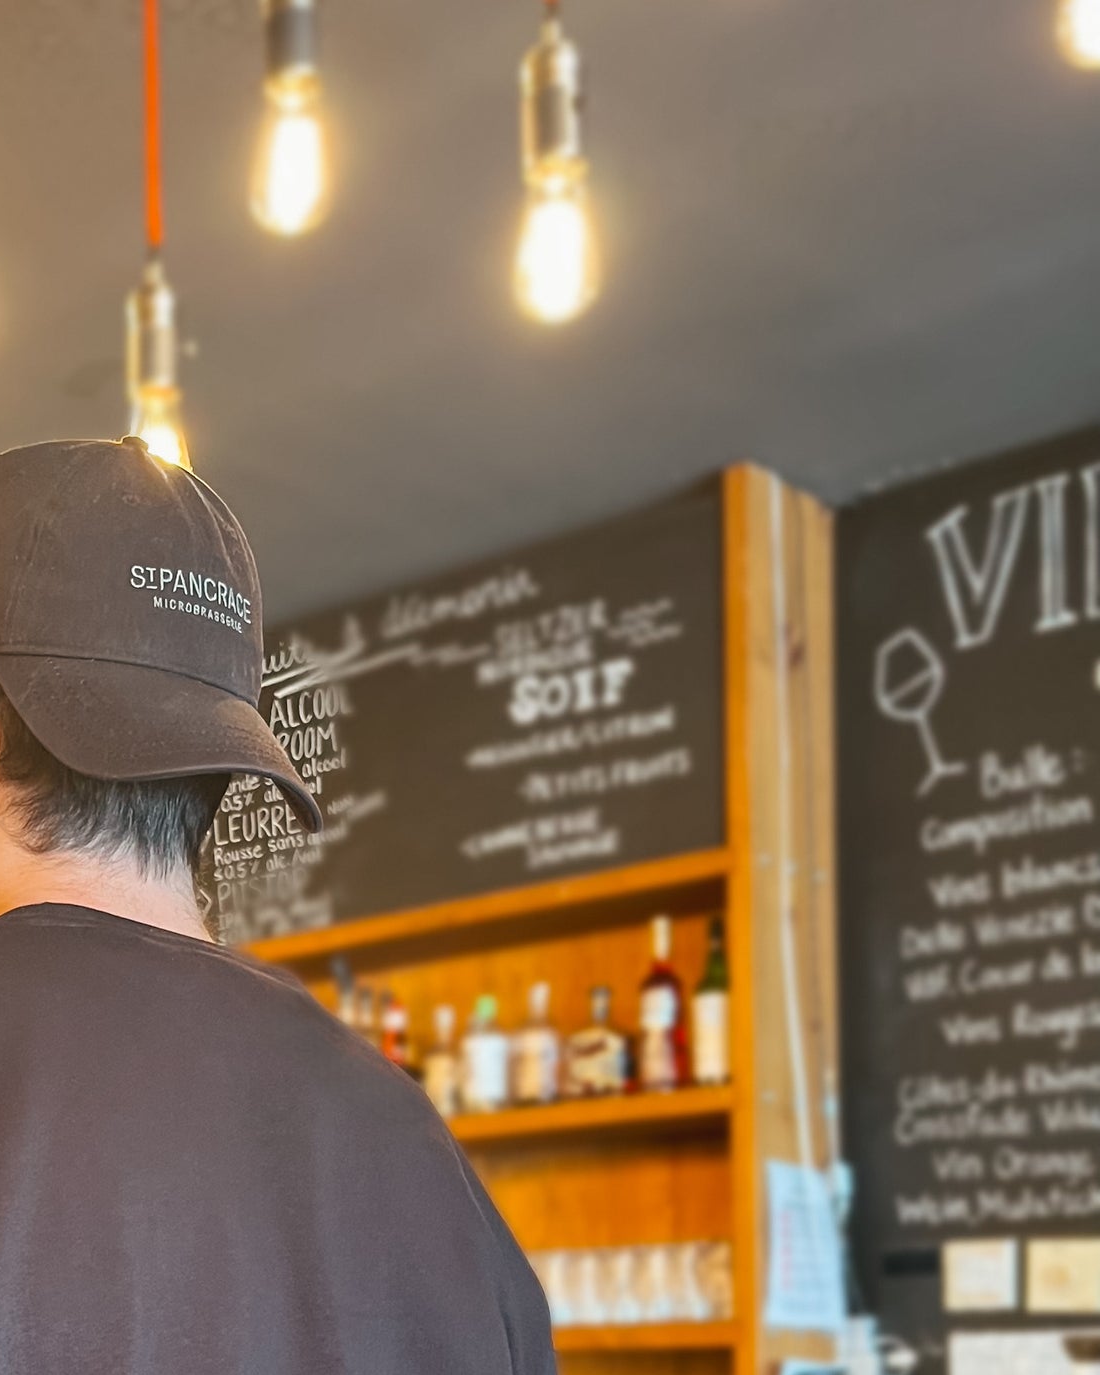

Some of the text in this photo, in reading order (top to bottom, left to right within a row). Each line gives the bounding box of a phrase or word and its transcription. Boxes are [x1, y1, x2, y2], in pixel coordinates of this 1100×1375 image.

[927, 463, 1100, 648] VI
[510, 657, 632, 724] SOIF
[214, 803, 302, 846] LEURRE
[214, 846, 264, 867] Rousse
[268, 834, 304, 853] sans
